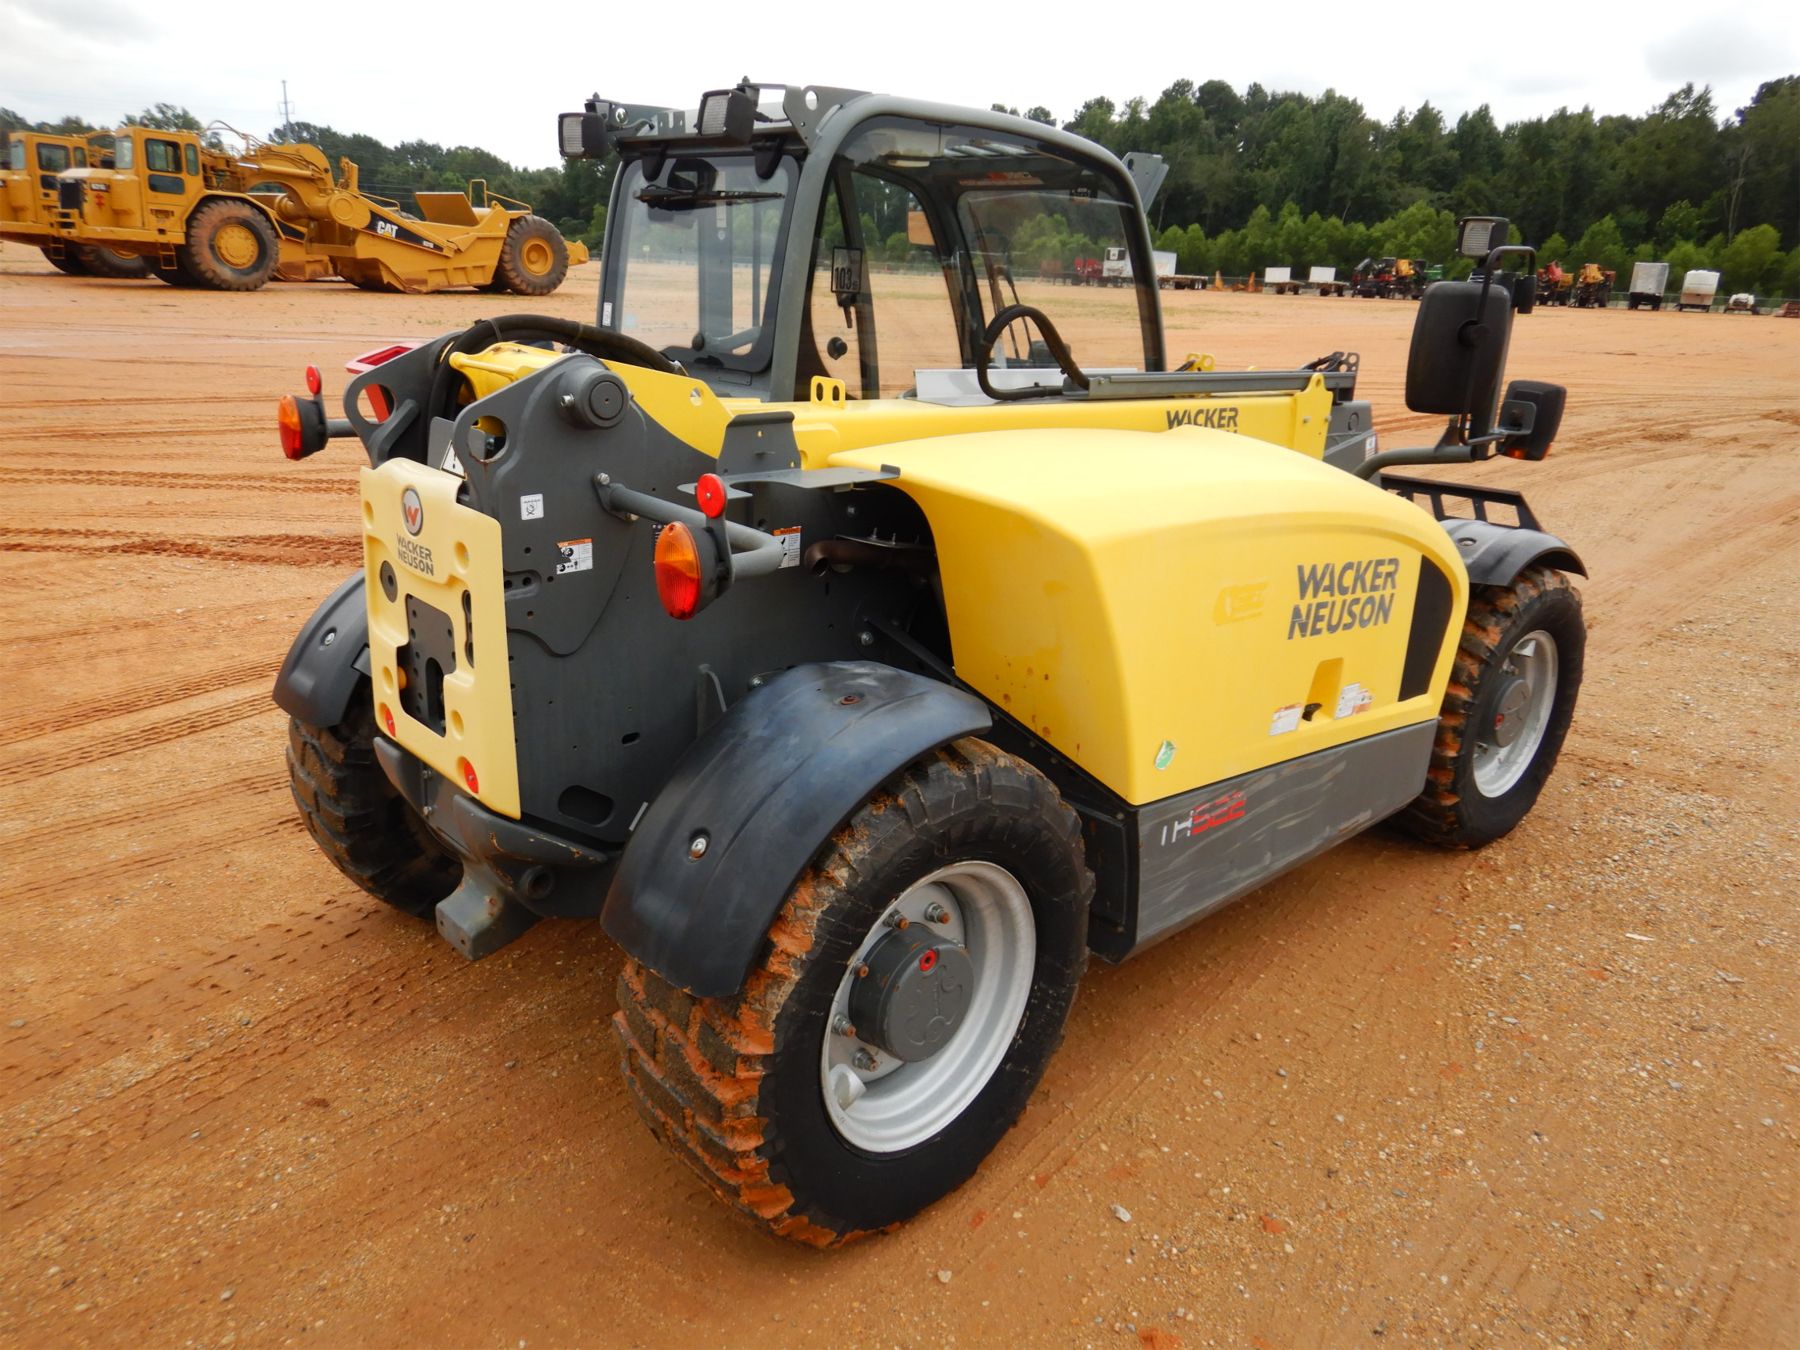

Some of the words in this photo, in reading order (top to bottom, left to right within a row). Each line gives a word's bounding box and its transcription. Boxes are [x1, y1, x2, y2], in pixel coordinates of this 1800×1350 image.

[376, 220, 399, 239] CAT
[1166, 407, 1239, 430] WACKER
[396, 533, 433, 562] WACKER
[397, 547, 434, 576] NEUSON
[1297, 557, 1400, 601] WACKER
[1287, 592, 1396, 641] NEUSON
